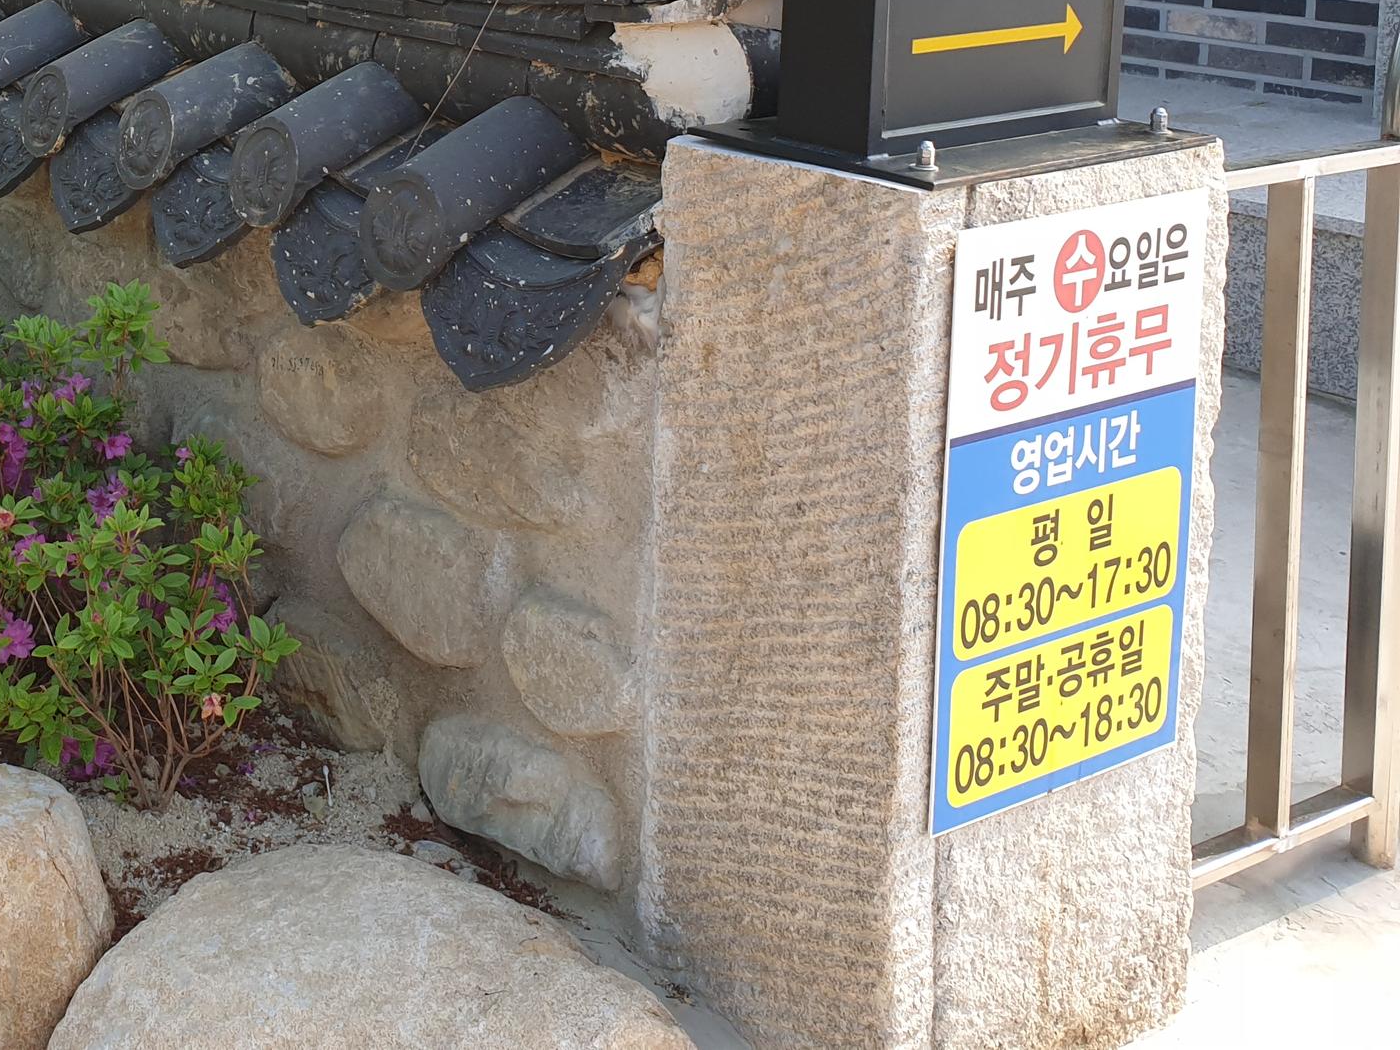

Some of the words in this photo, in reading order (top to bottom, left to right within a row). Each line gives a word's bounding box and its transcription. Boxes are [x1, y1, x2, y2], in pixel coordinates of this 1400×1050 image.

[974, 253, 1037, 321] 매주
[1061, 222, 1189, 308] 수요일은
[983, 303, 1173, 412] 정기휴무
[1010, 409, 1141, 495] 영업시간
[960, 540, 1171, 650] 08:30~17:30
[954, 676, 1162, 795] 08:30~18:30
